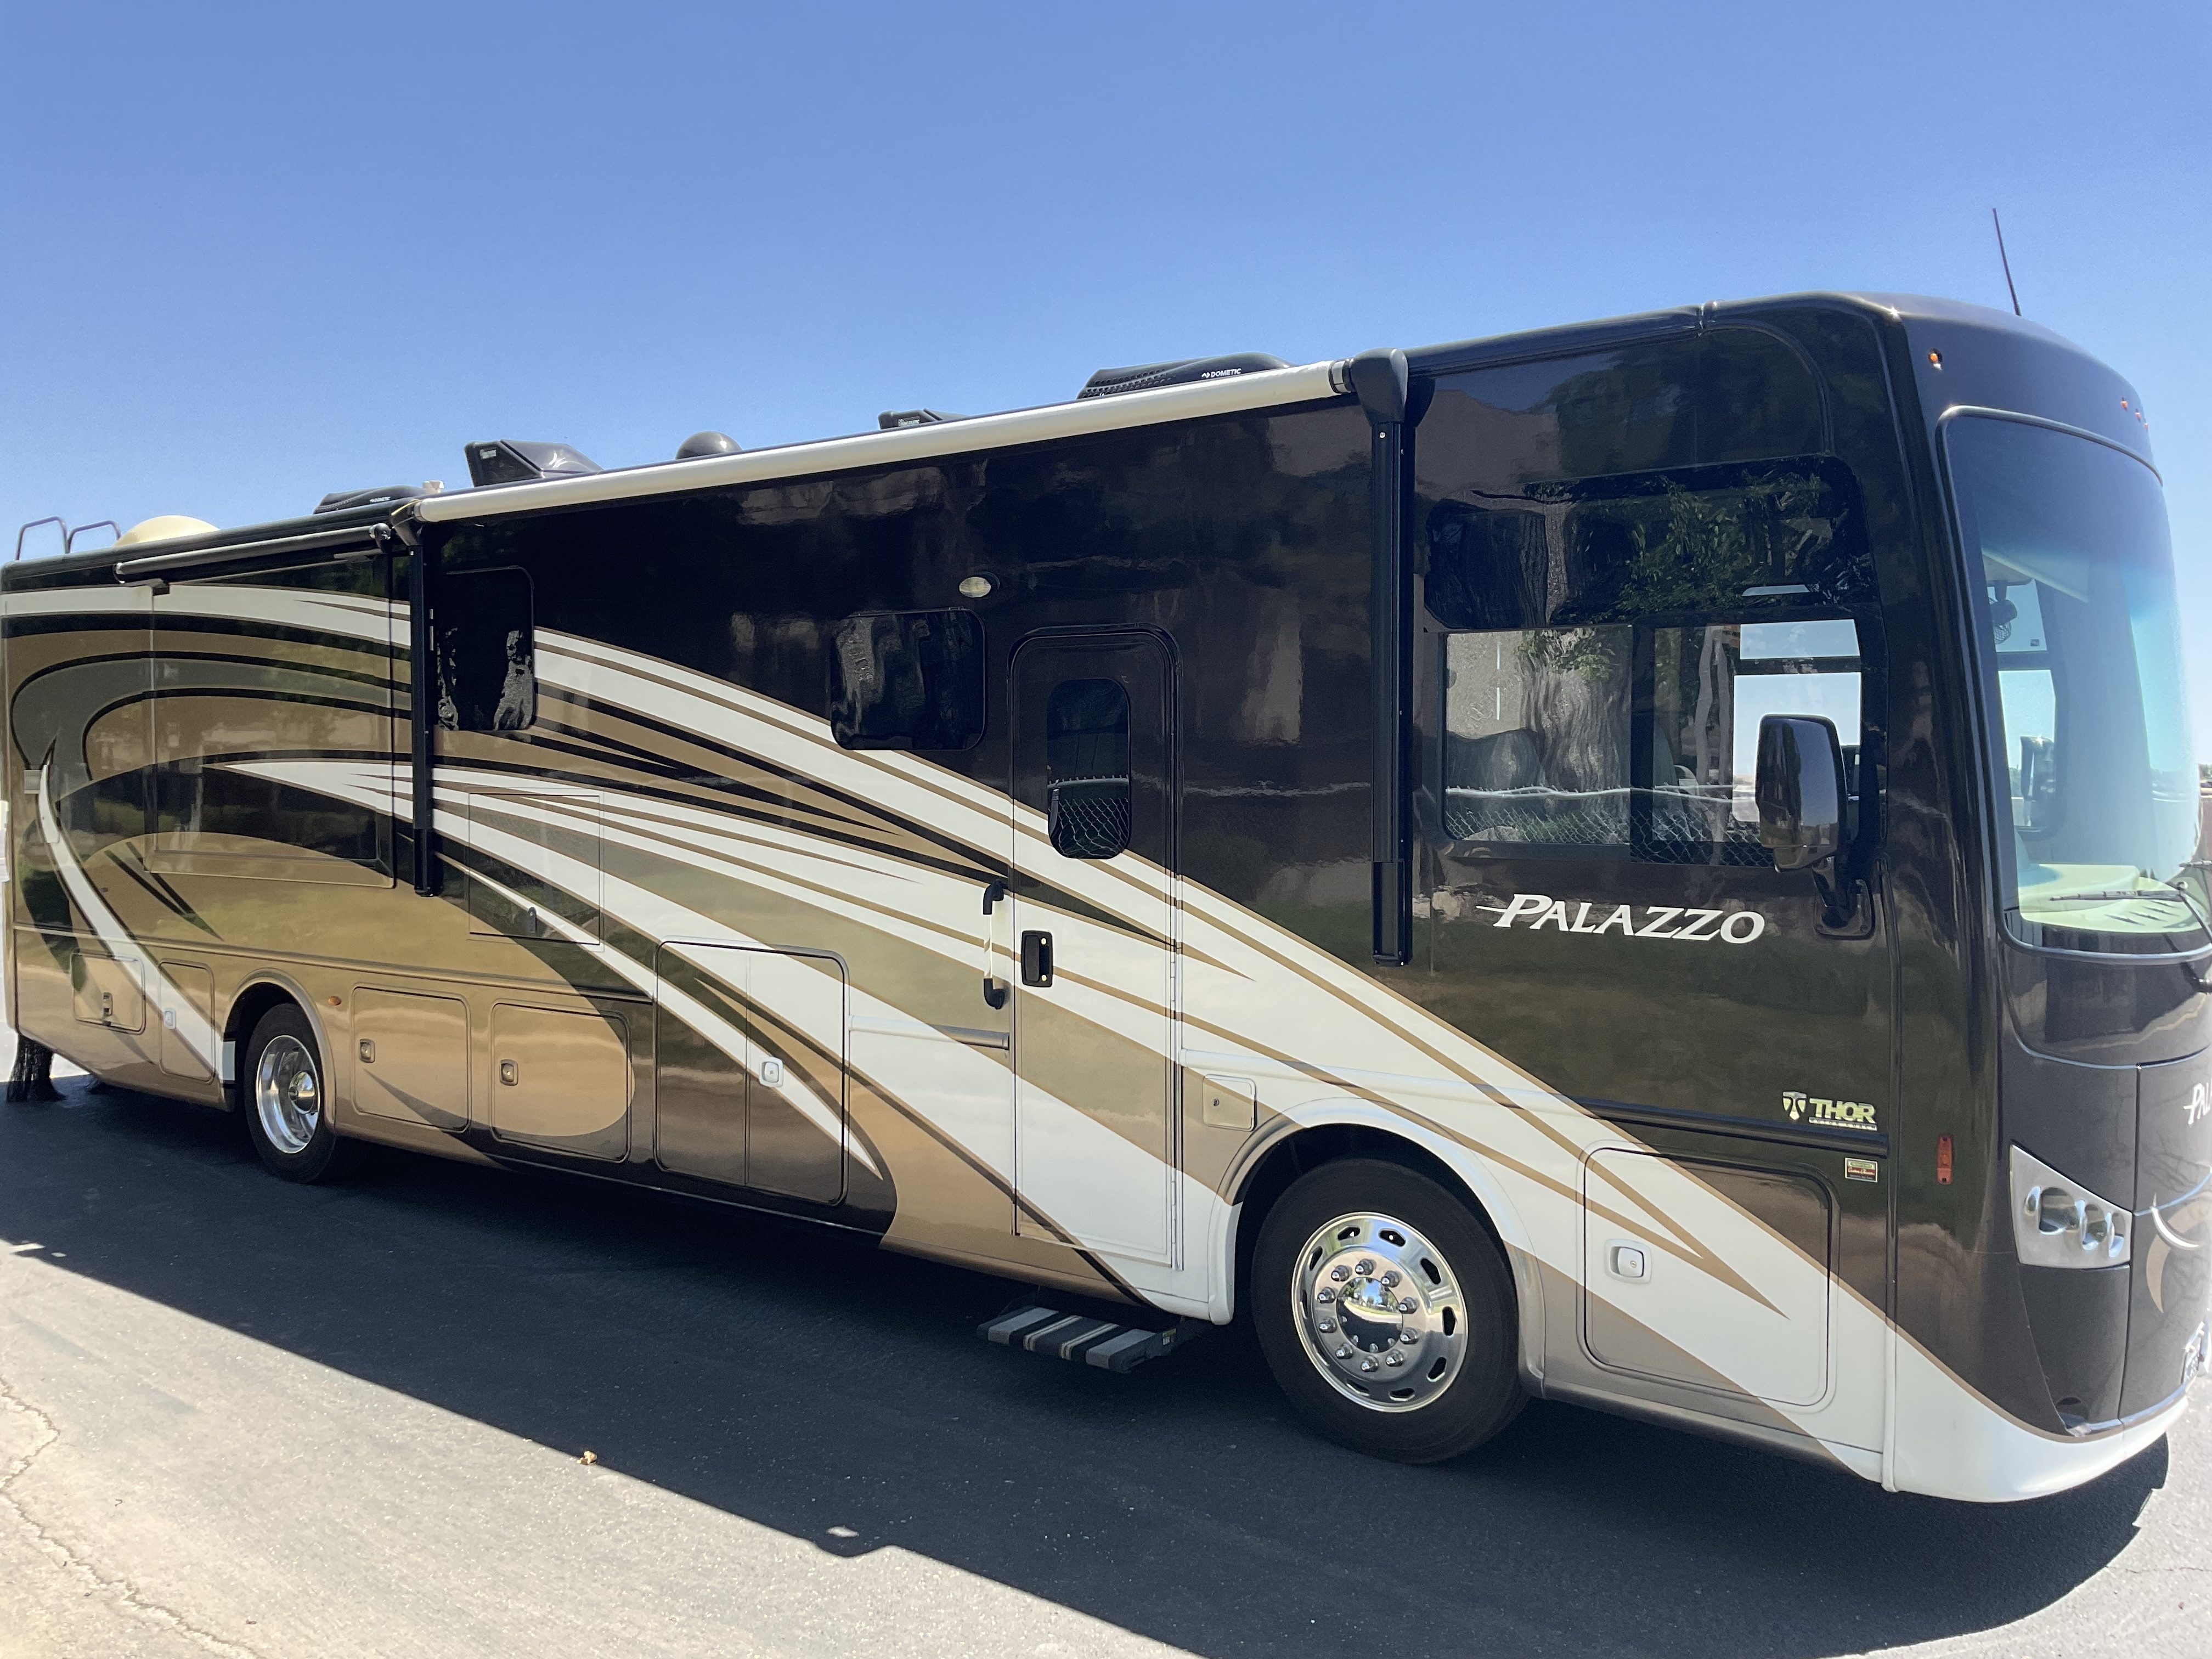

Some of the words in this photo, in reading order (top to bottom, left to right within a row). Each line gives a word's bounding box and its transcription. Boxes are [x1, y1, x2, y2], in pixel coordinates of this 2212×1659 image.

[1210, 368, 1241, 377] DOMETIC
[1476, 894, 1765, 944] PALAZZO
[1809, 1098, 1875, 1123] THOR
